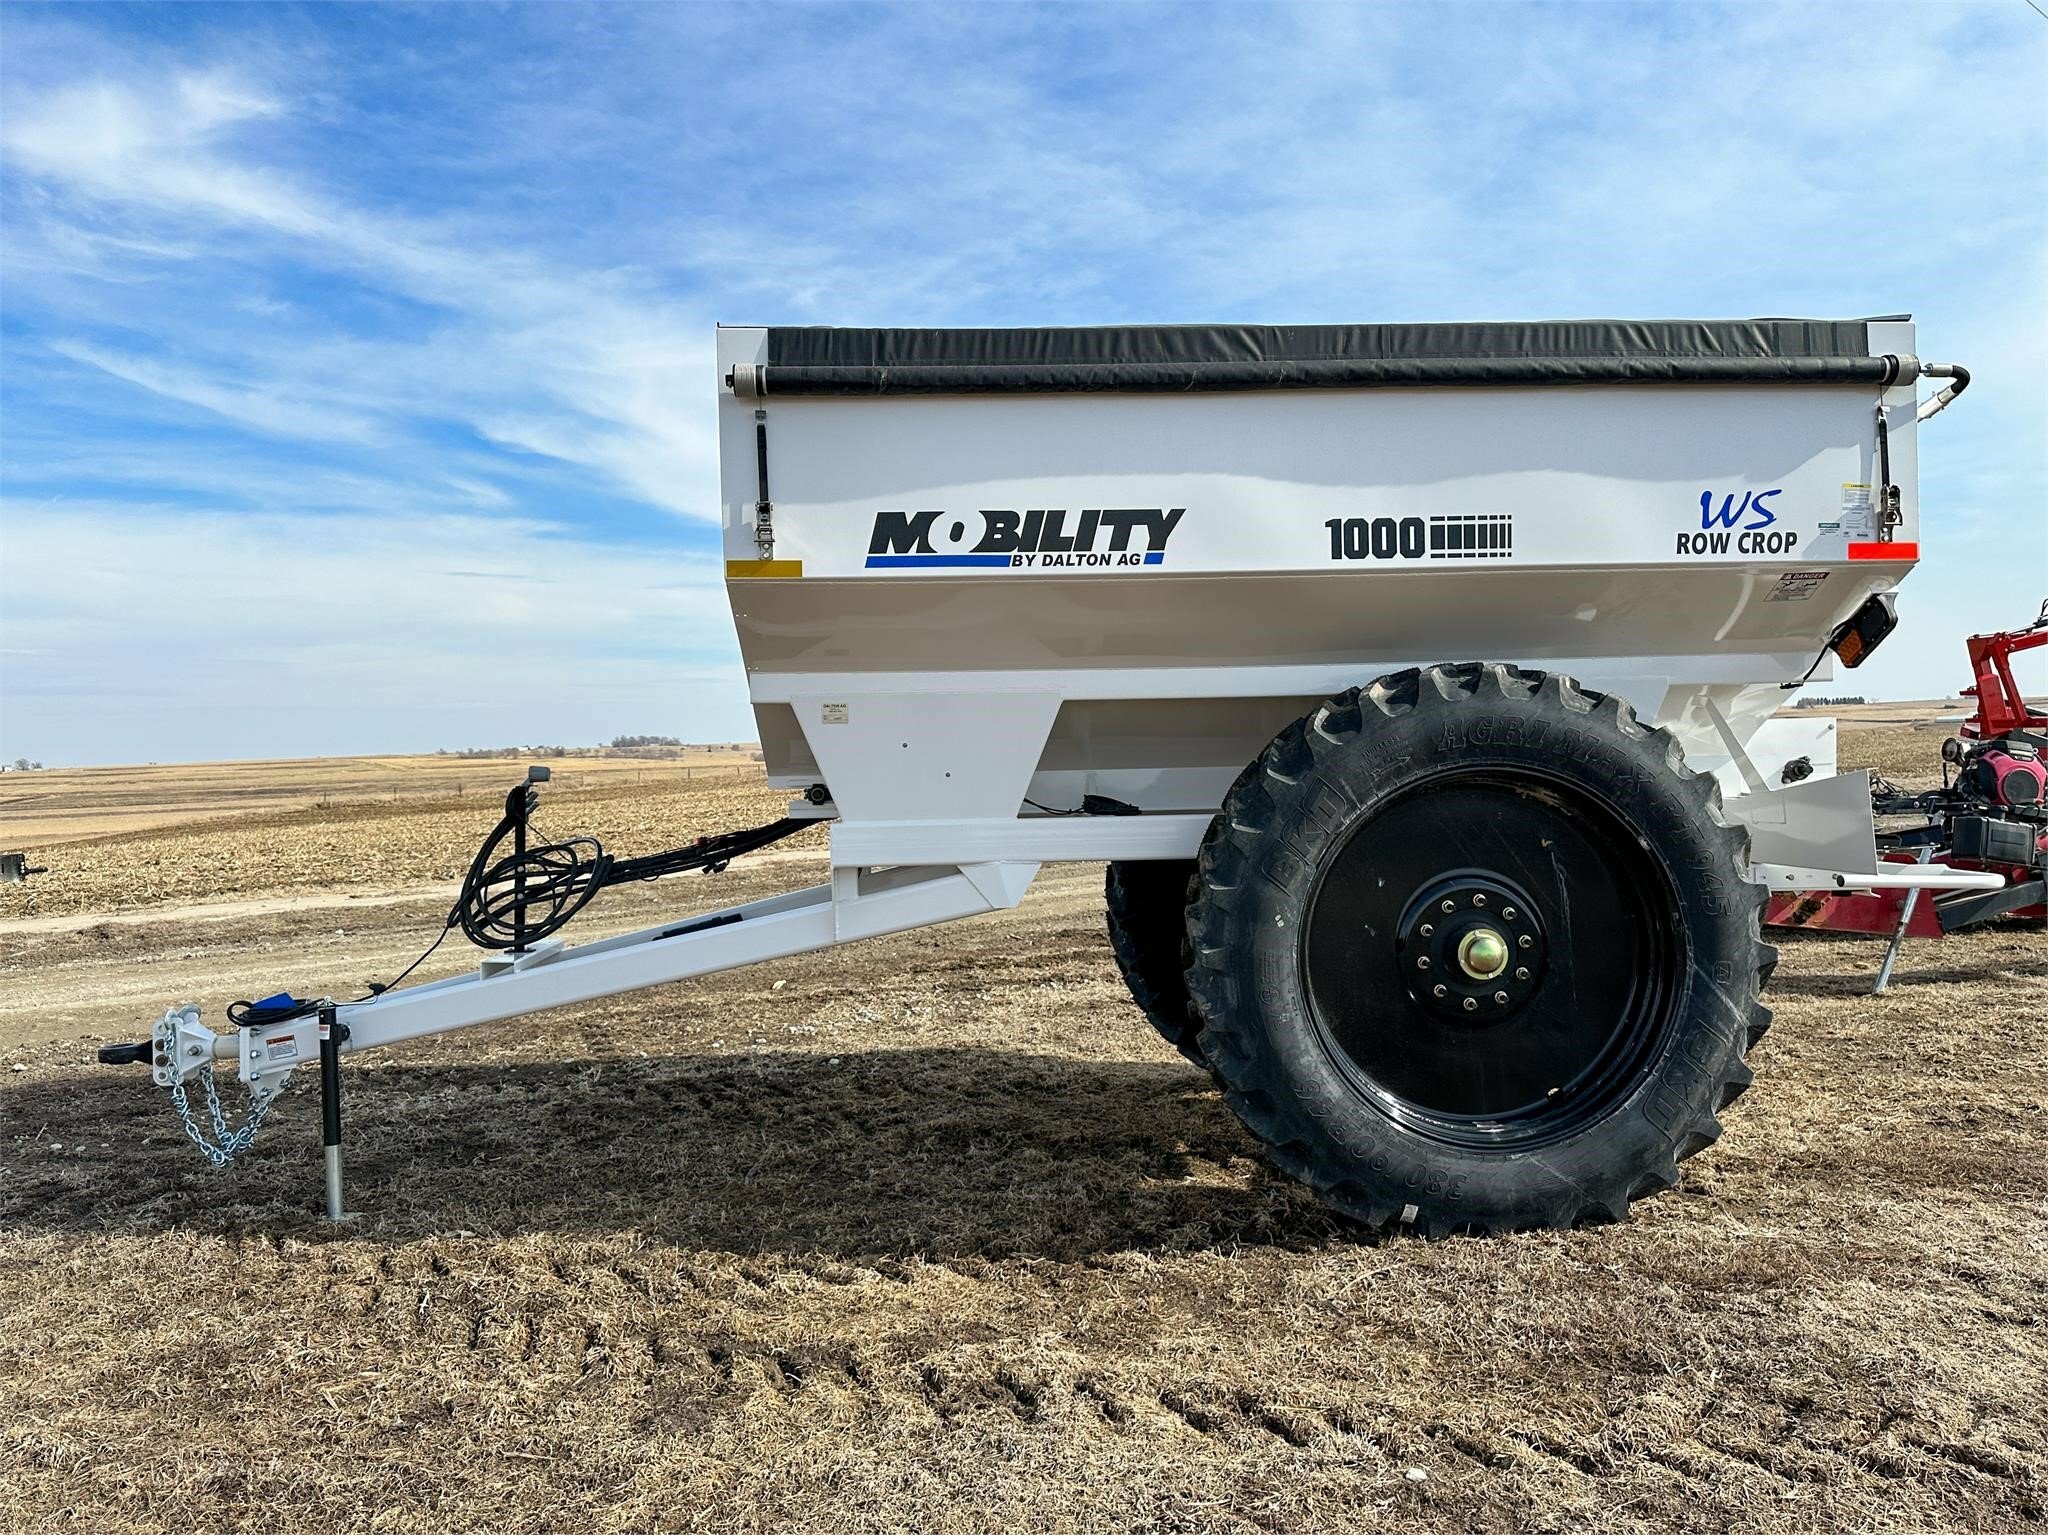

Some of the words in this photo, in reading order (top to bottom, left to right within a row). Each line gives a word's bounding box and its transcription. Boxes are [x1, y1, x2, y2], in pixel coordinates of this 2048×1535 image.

[1700, 489, 1782, 530] WS
[867, 509, 1186, 554] MOBILITY
[1325, 517, 1425, 559] 1000
[1676, 532, 1731, 554] ROW
[1737, 532, 1798, 554] CROP
[1011, 554, 1034, 567] BY
[1041, 554, 1111, 567] DALTON
[1116, 554, 1142, 567] AG
[1437, 715, 1551, 752] AGRI
[1265, 778, 1345, 893] BKT
